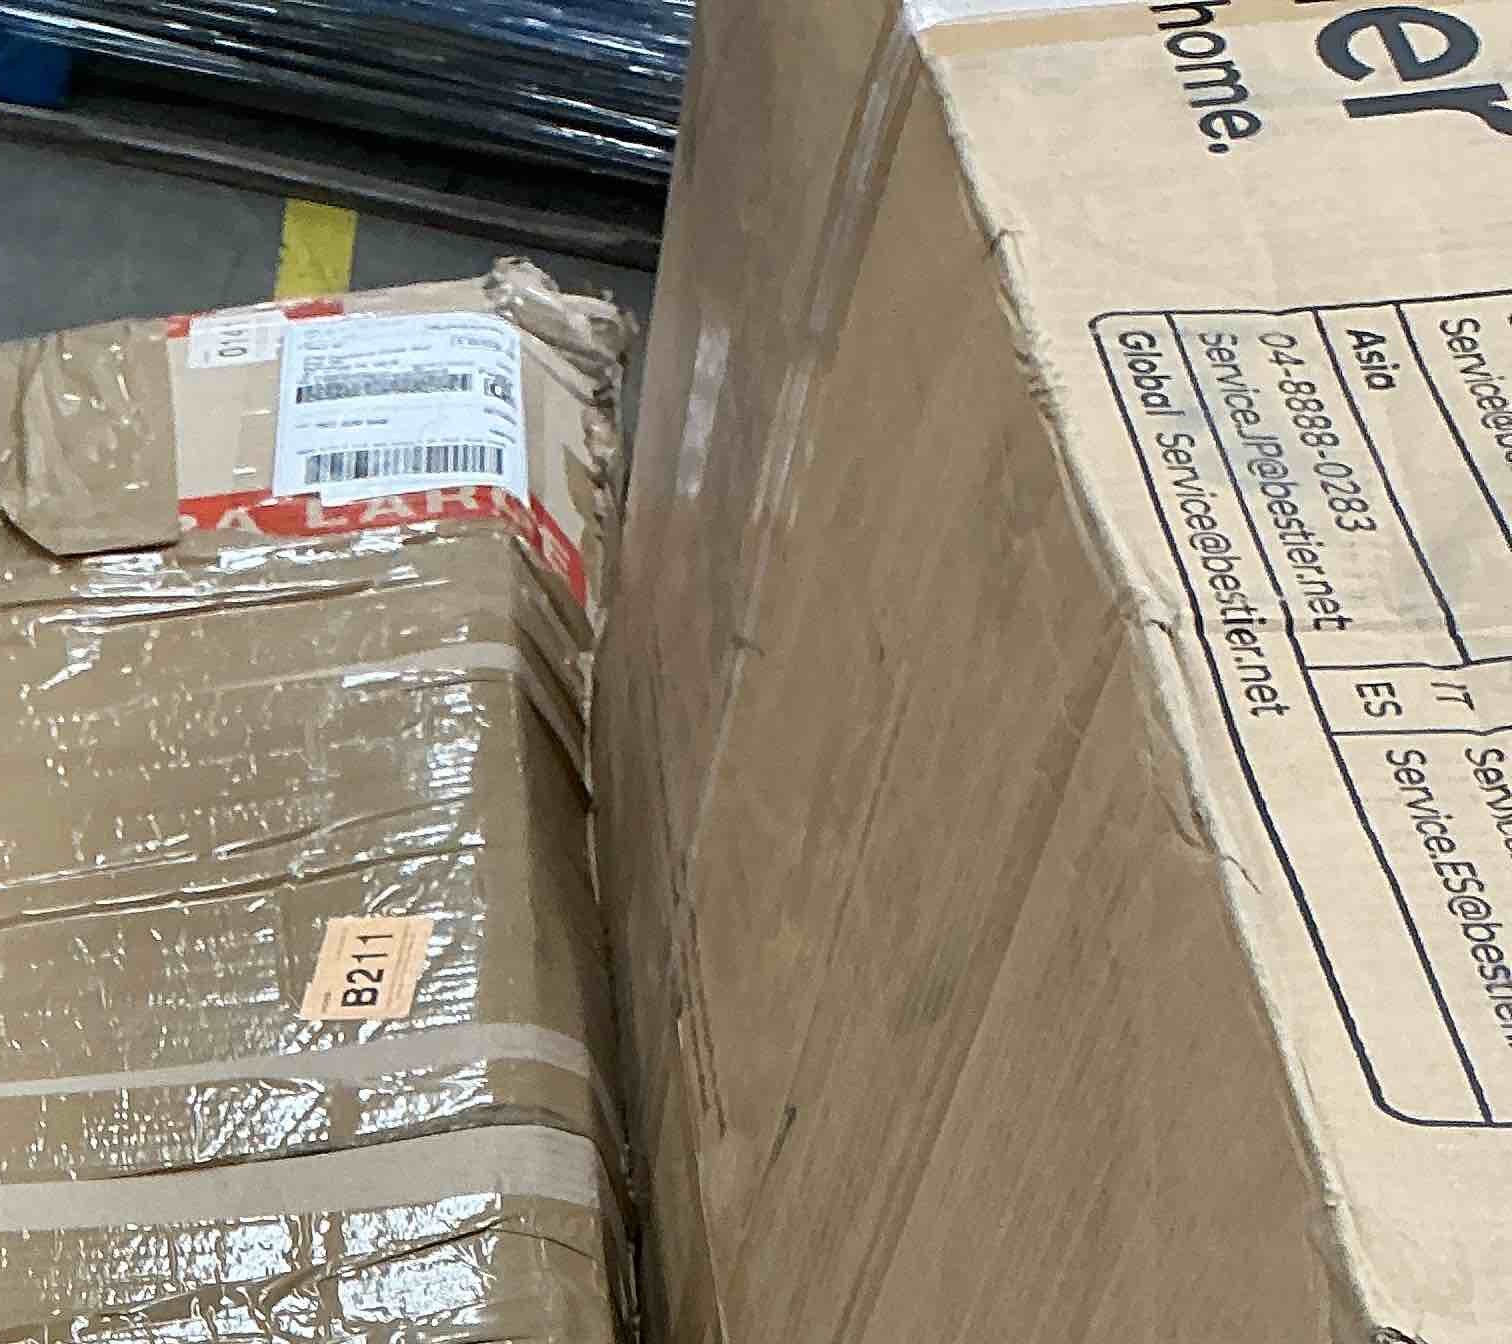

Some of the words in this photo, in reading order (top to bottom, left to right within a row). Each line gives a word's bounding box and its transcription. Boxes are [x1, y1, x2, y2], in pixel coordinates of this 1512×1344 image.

[1345, 328, 1401, 391] Asia
[1257, 331, 1377, 533] 04-8888-0283
[1117, 329, 1180, 417] Global
[1156, 431, 1290, 718] Service@bestier.net
[1354, 681, 1403, 718] ES
[1430, 680, 1475, 712] IT
[340, 934, 393, 1007] B211
